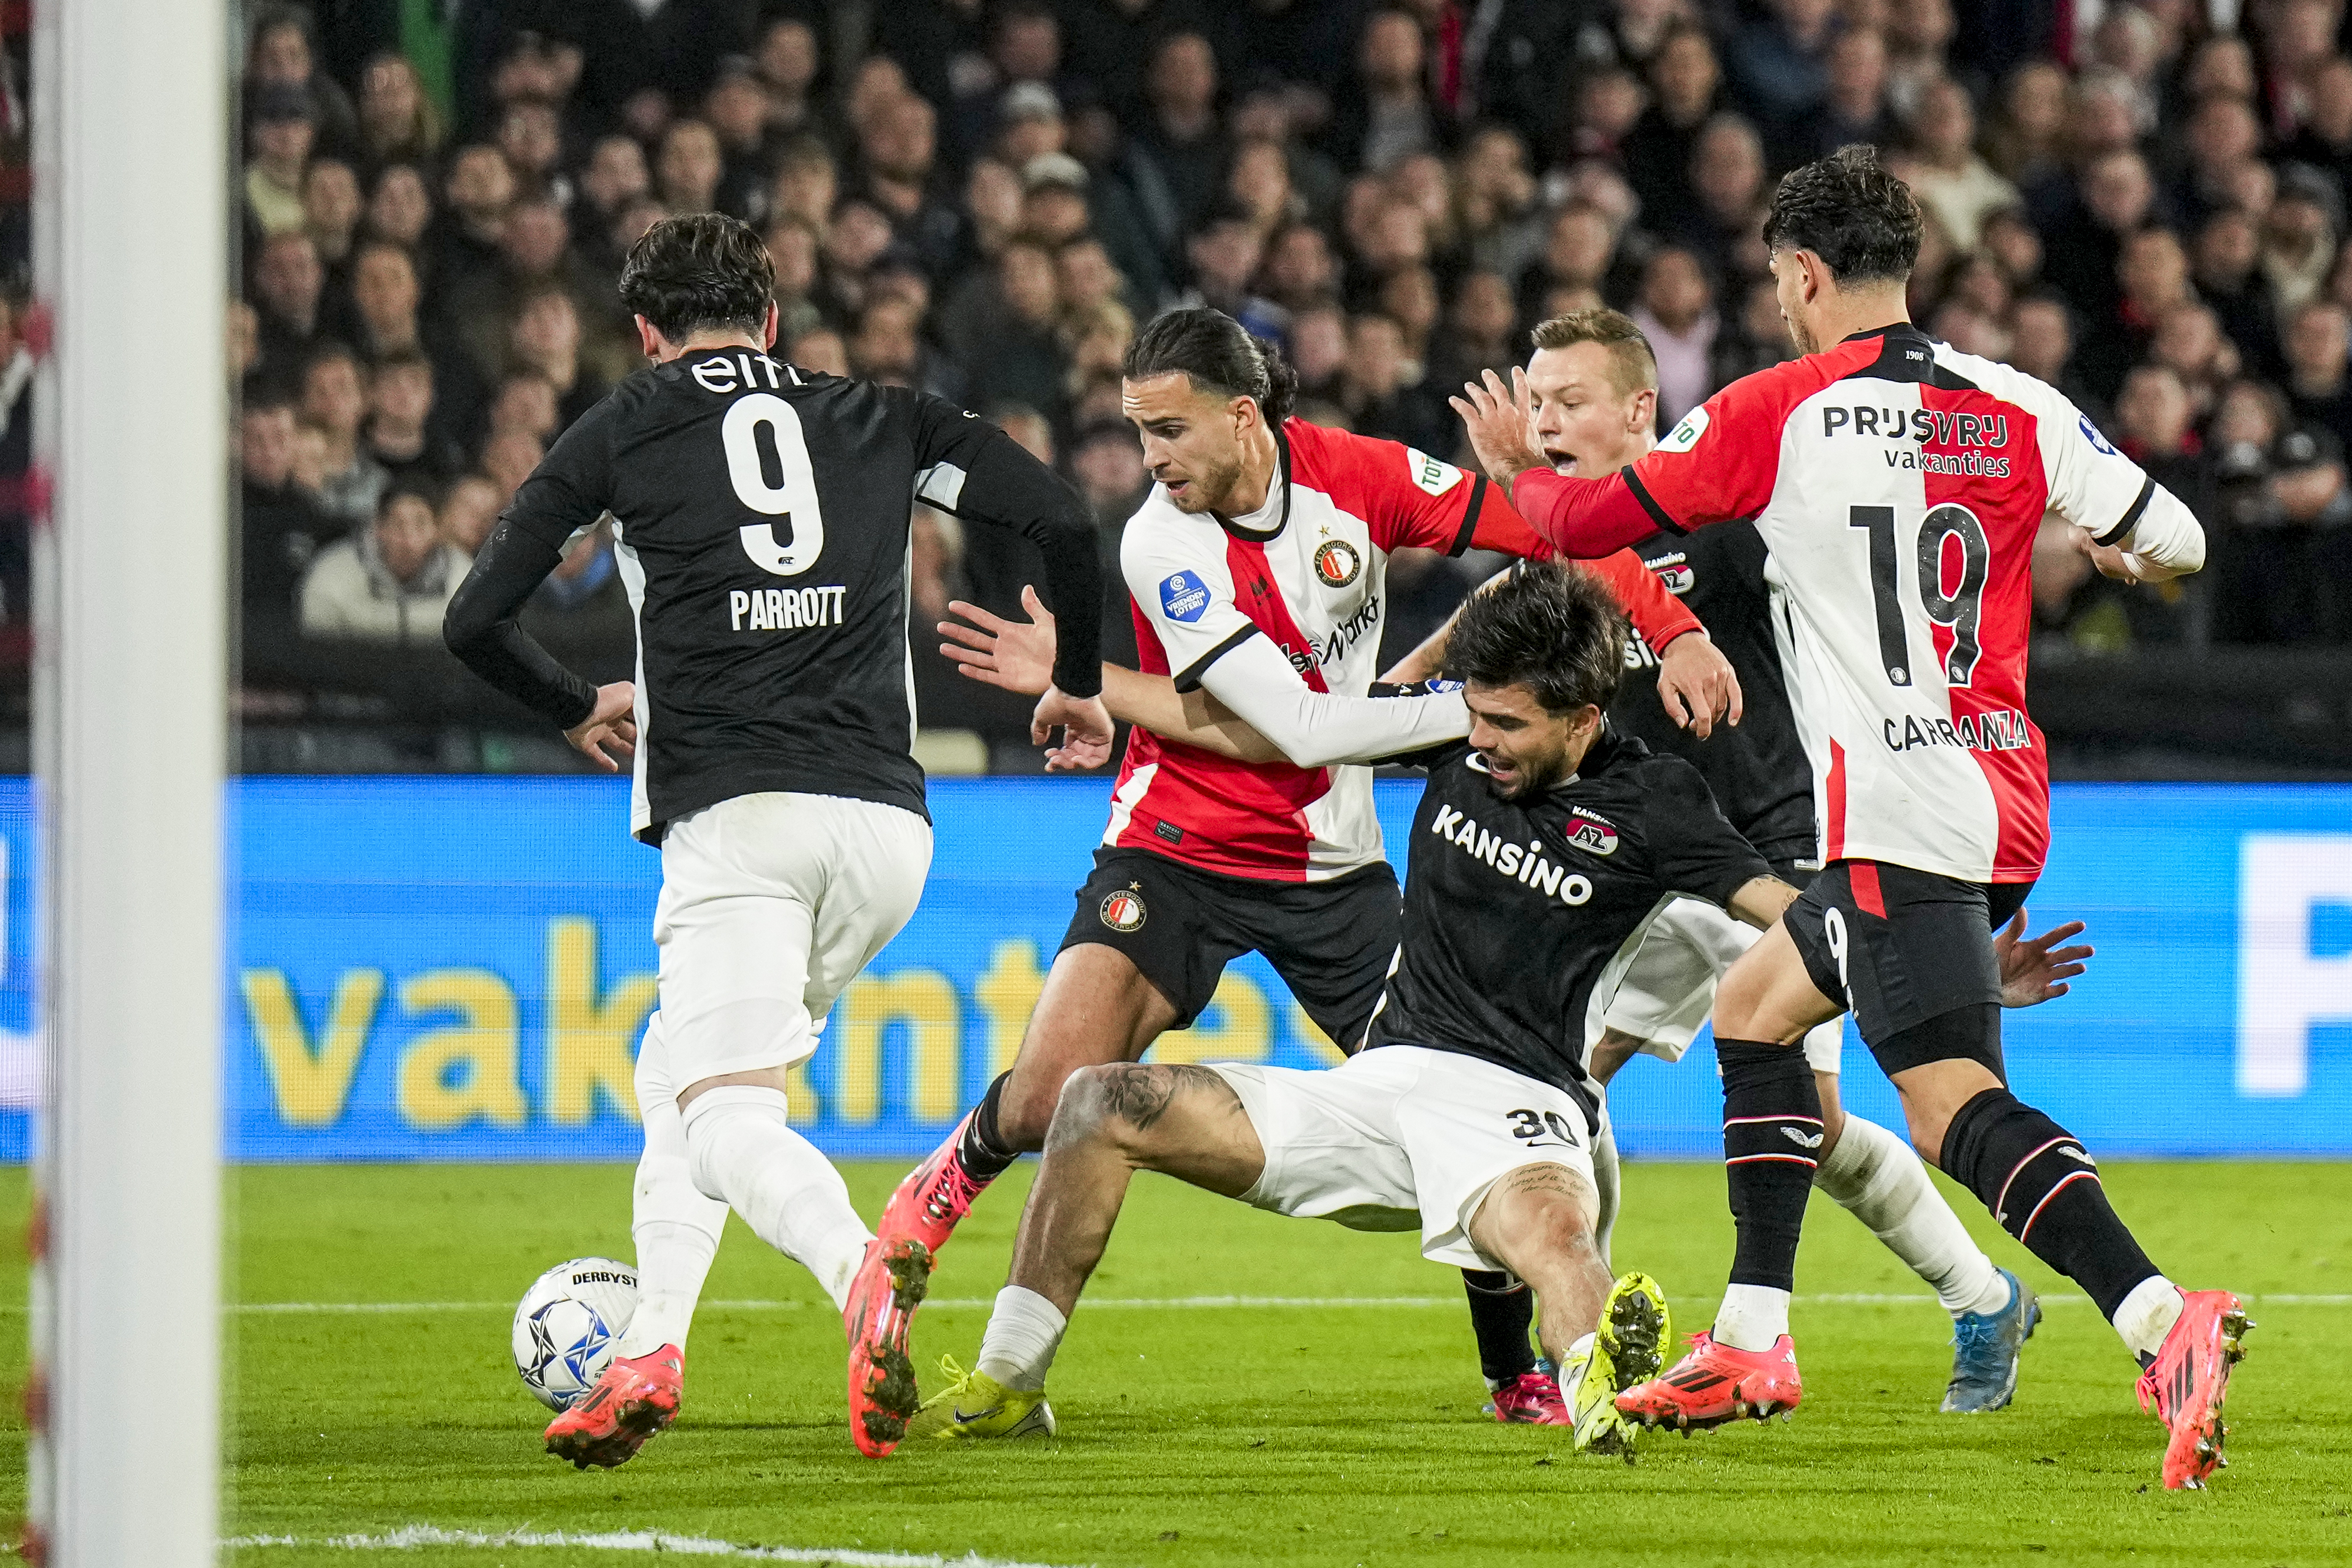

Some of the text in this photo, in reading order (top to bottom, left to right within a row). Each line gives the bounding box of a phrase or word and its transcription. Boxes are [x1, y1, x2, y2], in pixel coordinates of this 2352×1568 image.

[1905, 350, 1924, 361] 1908
[1673, 421, 1695, 444] TO
[1421, 454, 1442, 486] TOT
[1884, 446, 2010, 478] vakanties
[722, 393, 824, 576] 9
[1314, 541, 1353, 564] FEYENOORD
[729, 585, 846, 631] PARROTT
[1167, 590, 1206, 612] VRIENDEN
[1173, 598, 1204, 618] LOTERIJ
[1847, 504, 1989, 688] 19
[1884, 709, 2032, 752] CARRANZA
[1572, 823, 1608, 851] AZ
[1505, 1108, 1581, 1148] 30
[573, 1271, 637, 1289] DERBYST
